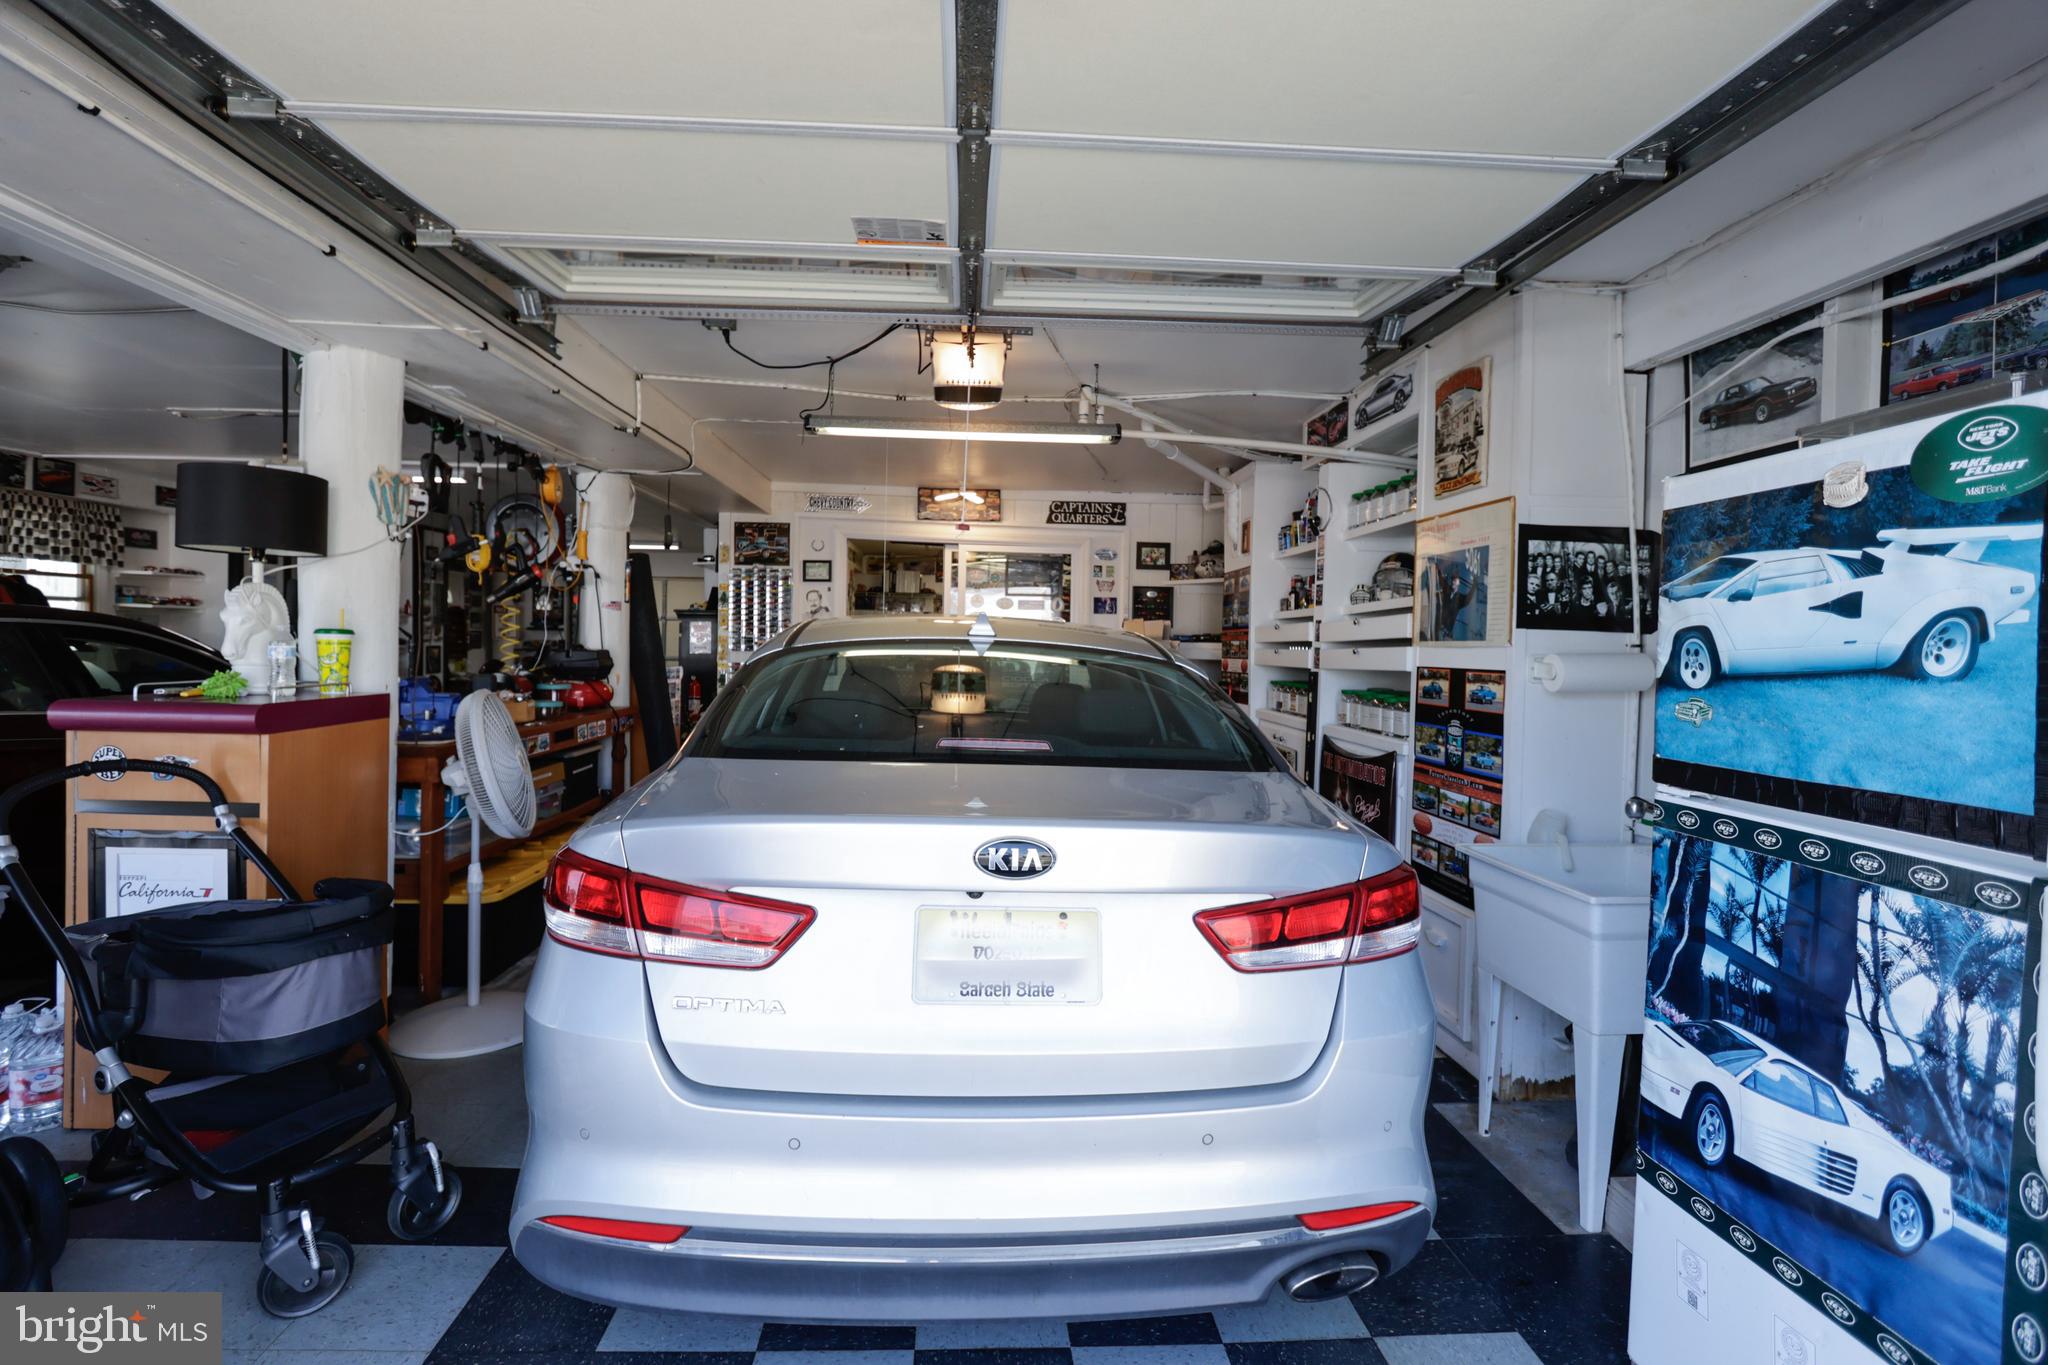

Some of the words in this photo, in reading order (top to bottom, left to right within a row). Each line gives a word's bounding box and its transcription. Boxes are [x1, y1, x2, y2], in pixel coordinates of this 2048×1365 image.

[1965, 426, 2010, 442] JETS
[1985, 422, 2003, 430] YORK
[1949, 456, 1992, 471] TAKE
[1964, 458, 2029, 477] FLIGHT
[1051, 501, 1112, 513] CAPTAIN'S
[1051, 513, 1109, 524] QUARTERS
[988, 847, 1043, 871] KIA
[118, 881, 201, 905] California
[671, 995, 786, 1015] OPTIMA
